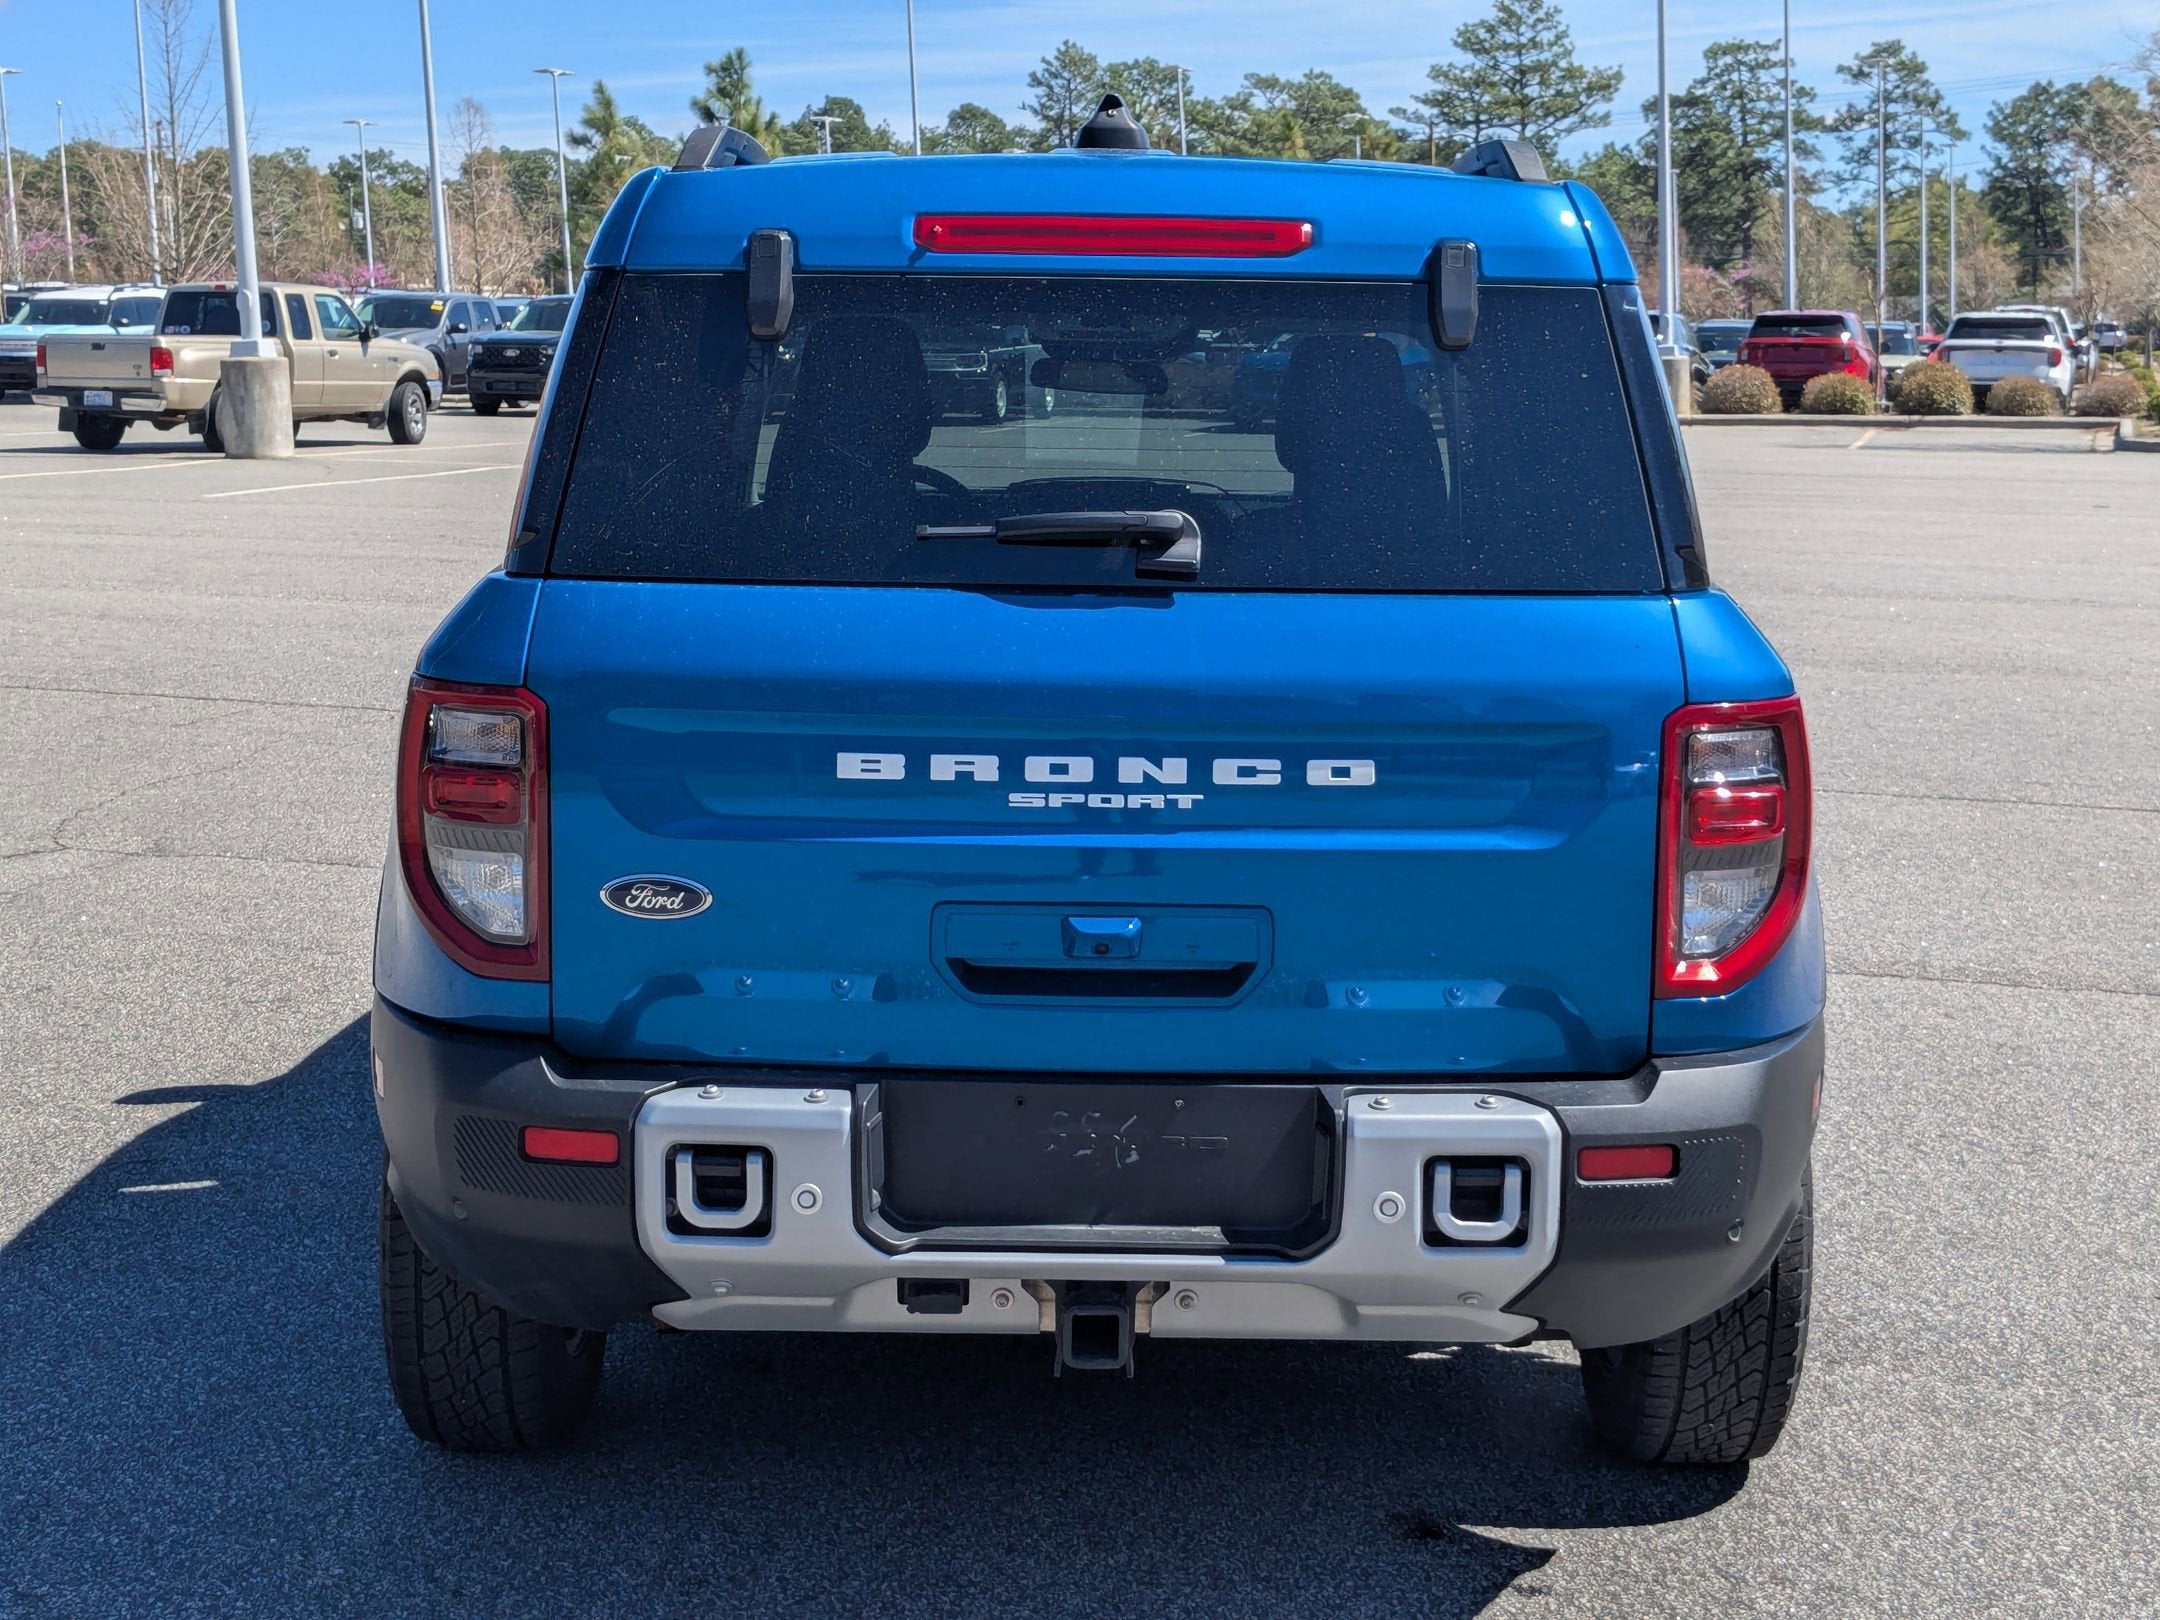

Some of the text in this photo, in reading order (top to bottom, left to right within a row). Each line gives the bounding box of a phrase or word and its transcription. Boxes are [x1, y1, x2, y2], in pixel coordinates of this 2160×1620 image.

[836, 752, 1376, 786] BRONCO
[1008, 792, 1204, 809] SPORT
[625, 883, 685, 909] Ford
